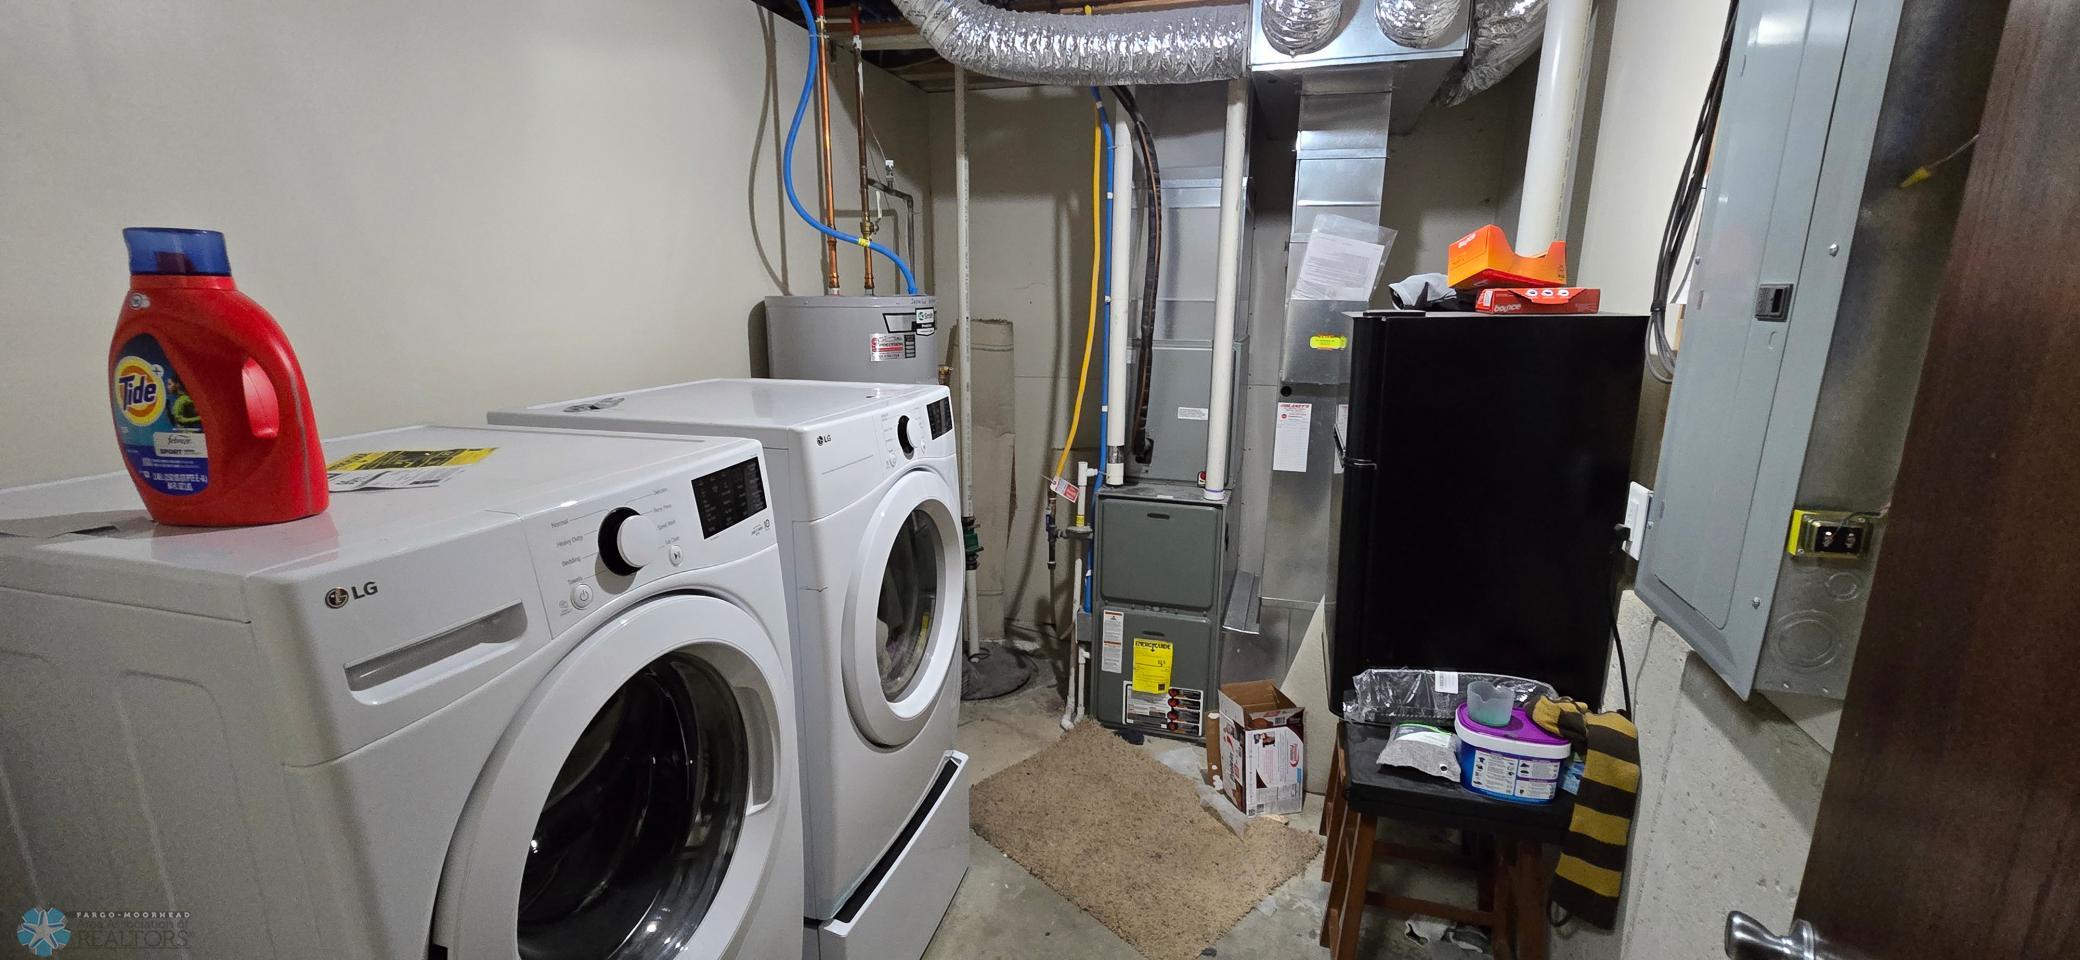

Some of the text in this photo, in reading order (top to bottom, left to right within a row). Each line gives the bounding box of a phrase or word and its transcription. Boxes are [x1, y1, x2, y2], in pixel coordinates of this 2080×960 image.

[118, 374, 157, 411] Tide
[824, 434, 832, 443] LG
[351, 581, 378, 600] LG
